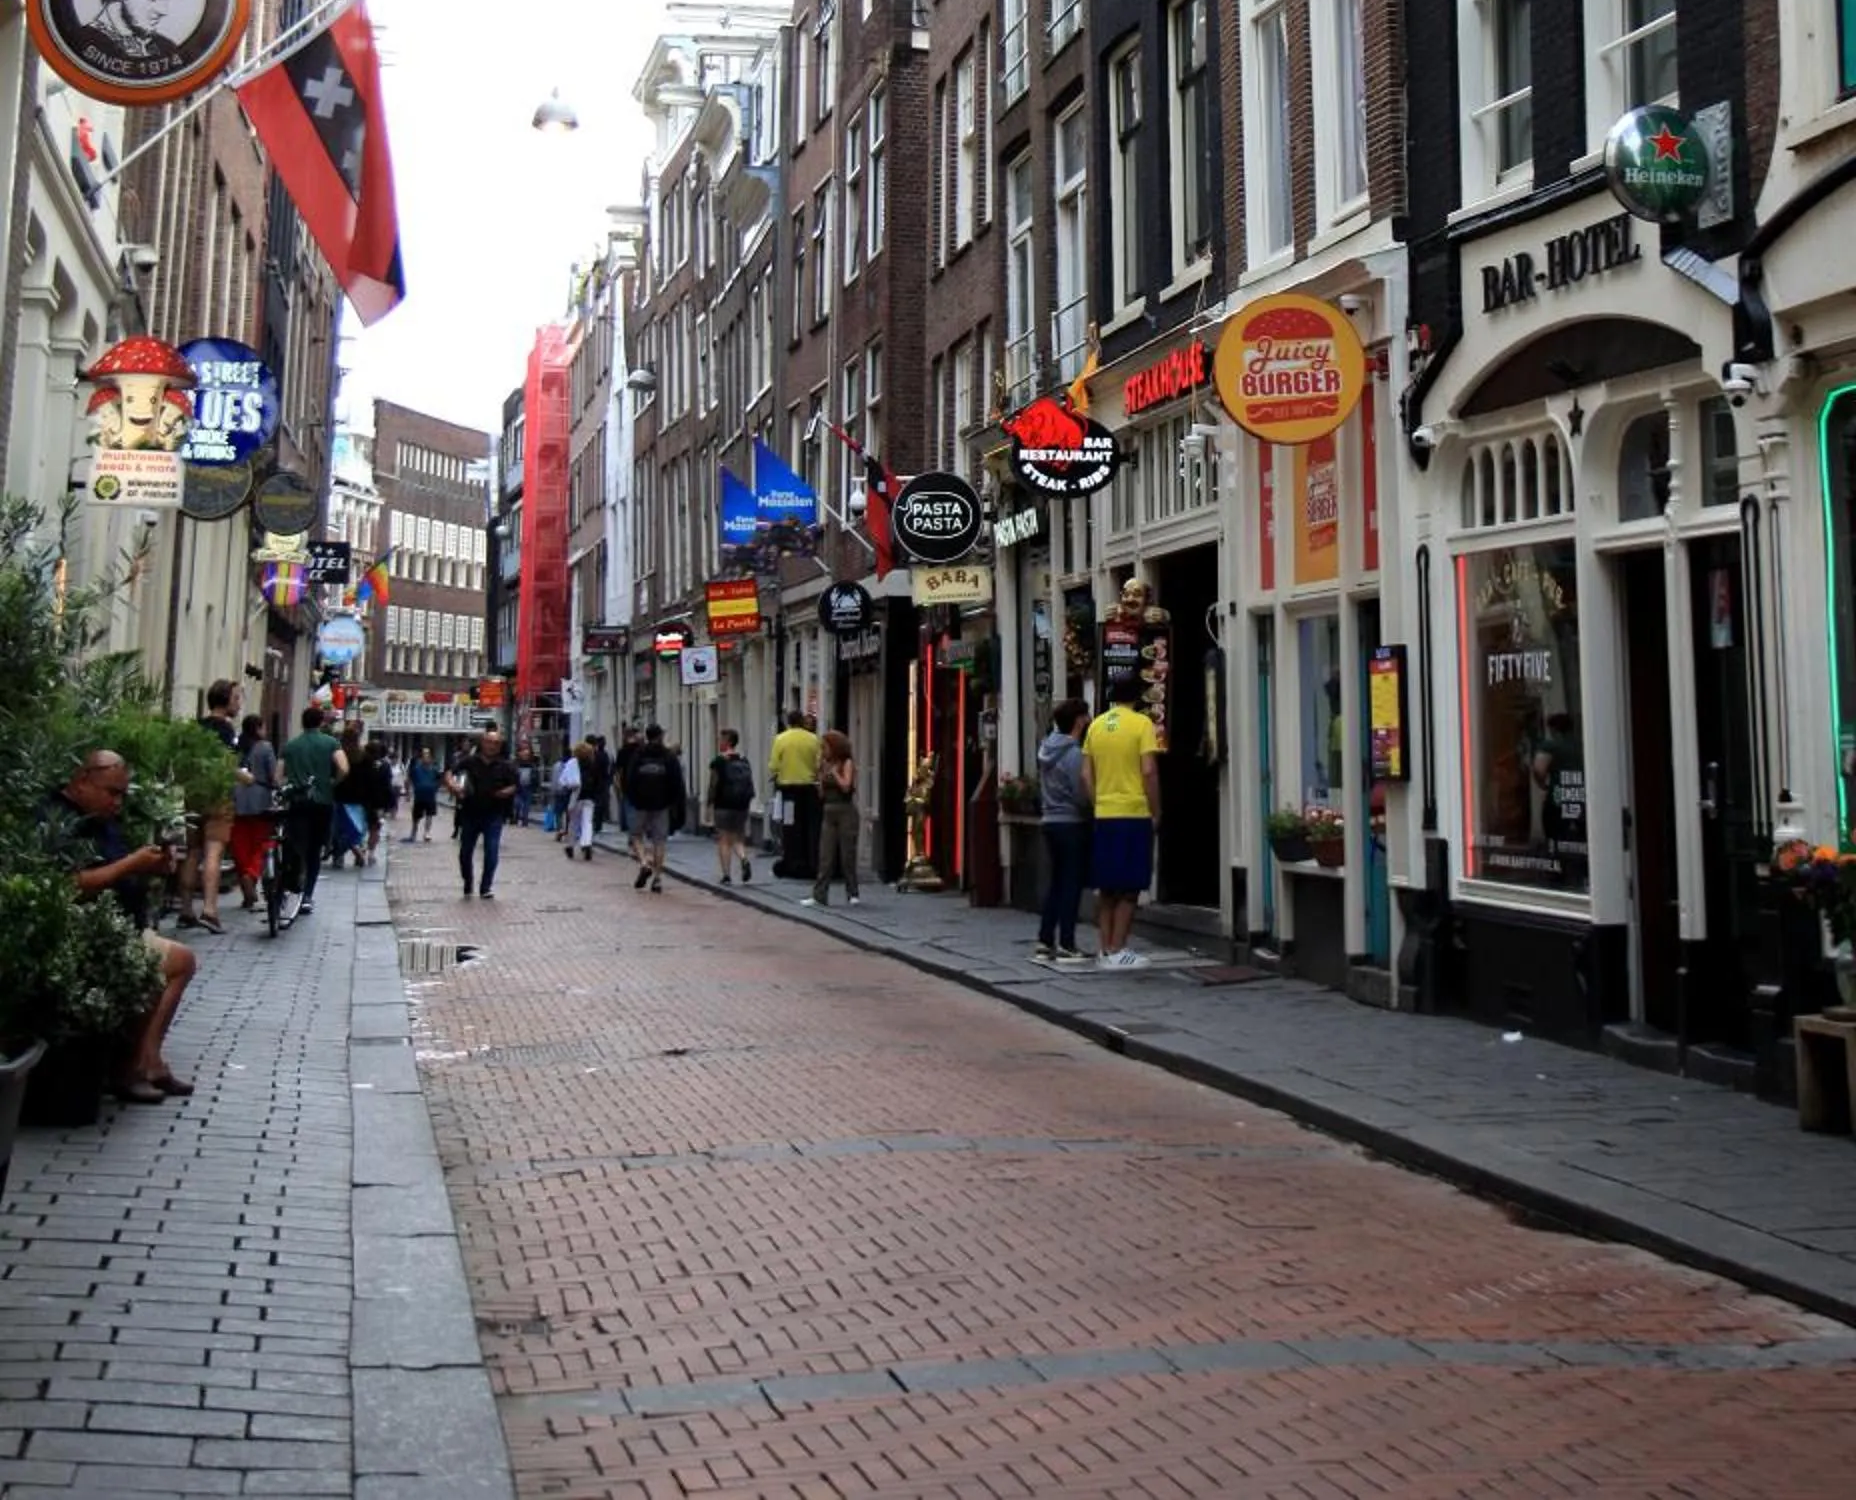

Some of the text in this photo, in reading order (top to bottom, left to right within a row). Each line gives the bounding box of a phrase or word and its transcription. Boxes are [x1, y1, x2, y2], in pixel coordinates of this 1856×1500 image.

[83, 44, 183, 74] SINCE 1974
[1624, 167, 1703, 187] Heineken
[1481, 212, 1642, 313] BAR-HOTEL
[1249, 336, 1330, 374] Juicy
[201, 361, 262, 389] STREET
[1123, 341, 1205, 417] STEAKHOUSE
[1241, 369, 1342, 397] BURGER
[1083, 437, 1112, 449] BAR
[101, 451, 173, 462] mushrooms
[1019, 449, 1113, 462] RESTAURANT
[95, 463, 132, 471] seeds
[145, 465, 177, 473] more
[1021, 463, 1067, 491] STEAK
[1077, 465, 1110, 490] RIBS
[913, 502, 963, 516] PASTA
[913, 517, 963, 531] PASTA
[925, 569, 980, 593] BABA
